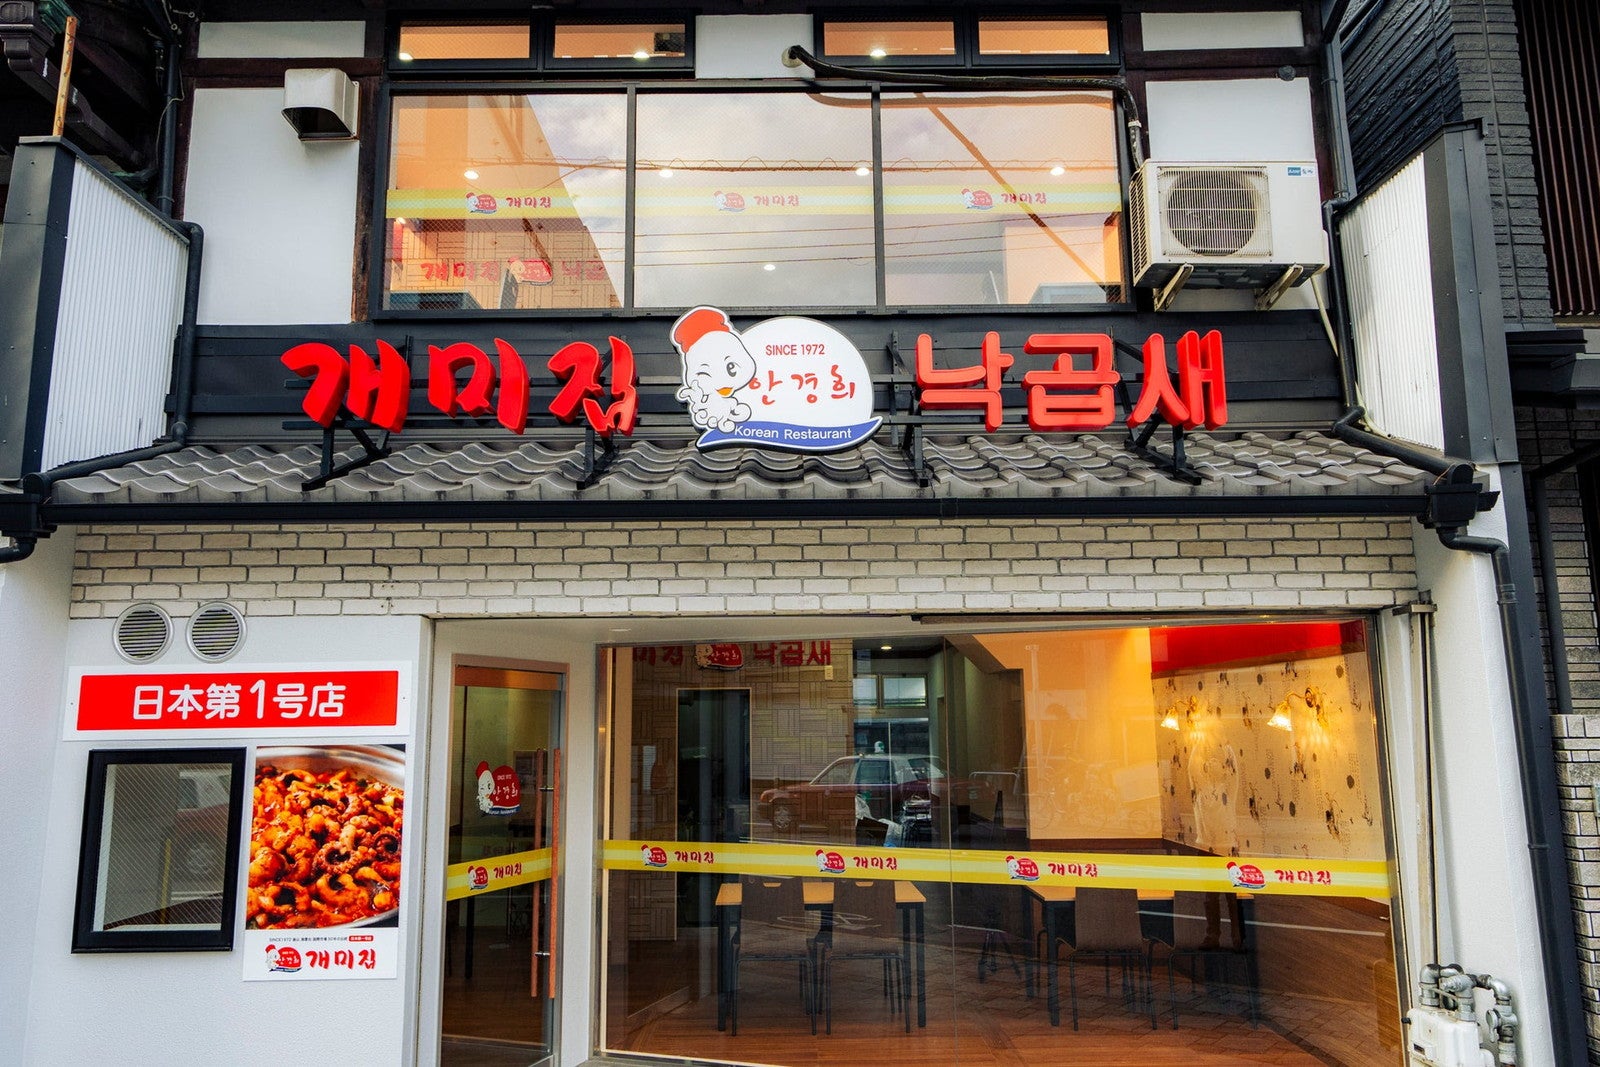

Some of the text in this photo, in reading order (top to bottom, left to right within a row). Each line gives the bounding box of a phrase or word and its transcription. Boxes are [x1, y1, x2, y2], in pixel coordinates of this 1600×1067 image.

[506, 196, 552, 209] 개미집
[765, 343, 825, 356] SINCE 1972
[280, 335, 639, 437] 개미집
[748, 364, 856, 405] 안경희
[916, 329, 1228, 433] 낙곱새
[734, 425, 852, 440] Korean Restaurant
[753, 640, 833, 666] 낙곱새
[132, 679, 347, 721] 日本第1号店
[674, 850, 715, 864] 개미집
[853, 856, 897, 870] 개미집
[493, 862, 522, 879] 개미집
[1047, 862, 1098, 878] 개미집
[1274, 869, 1332, 885] 개미집
[305, 949, 376, 969] 개미집
